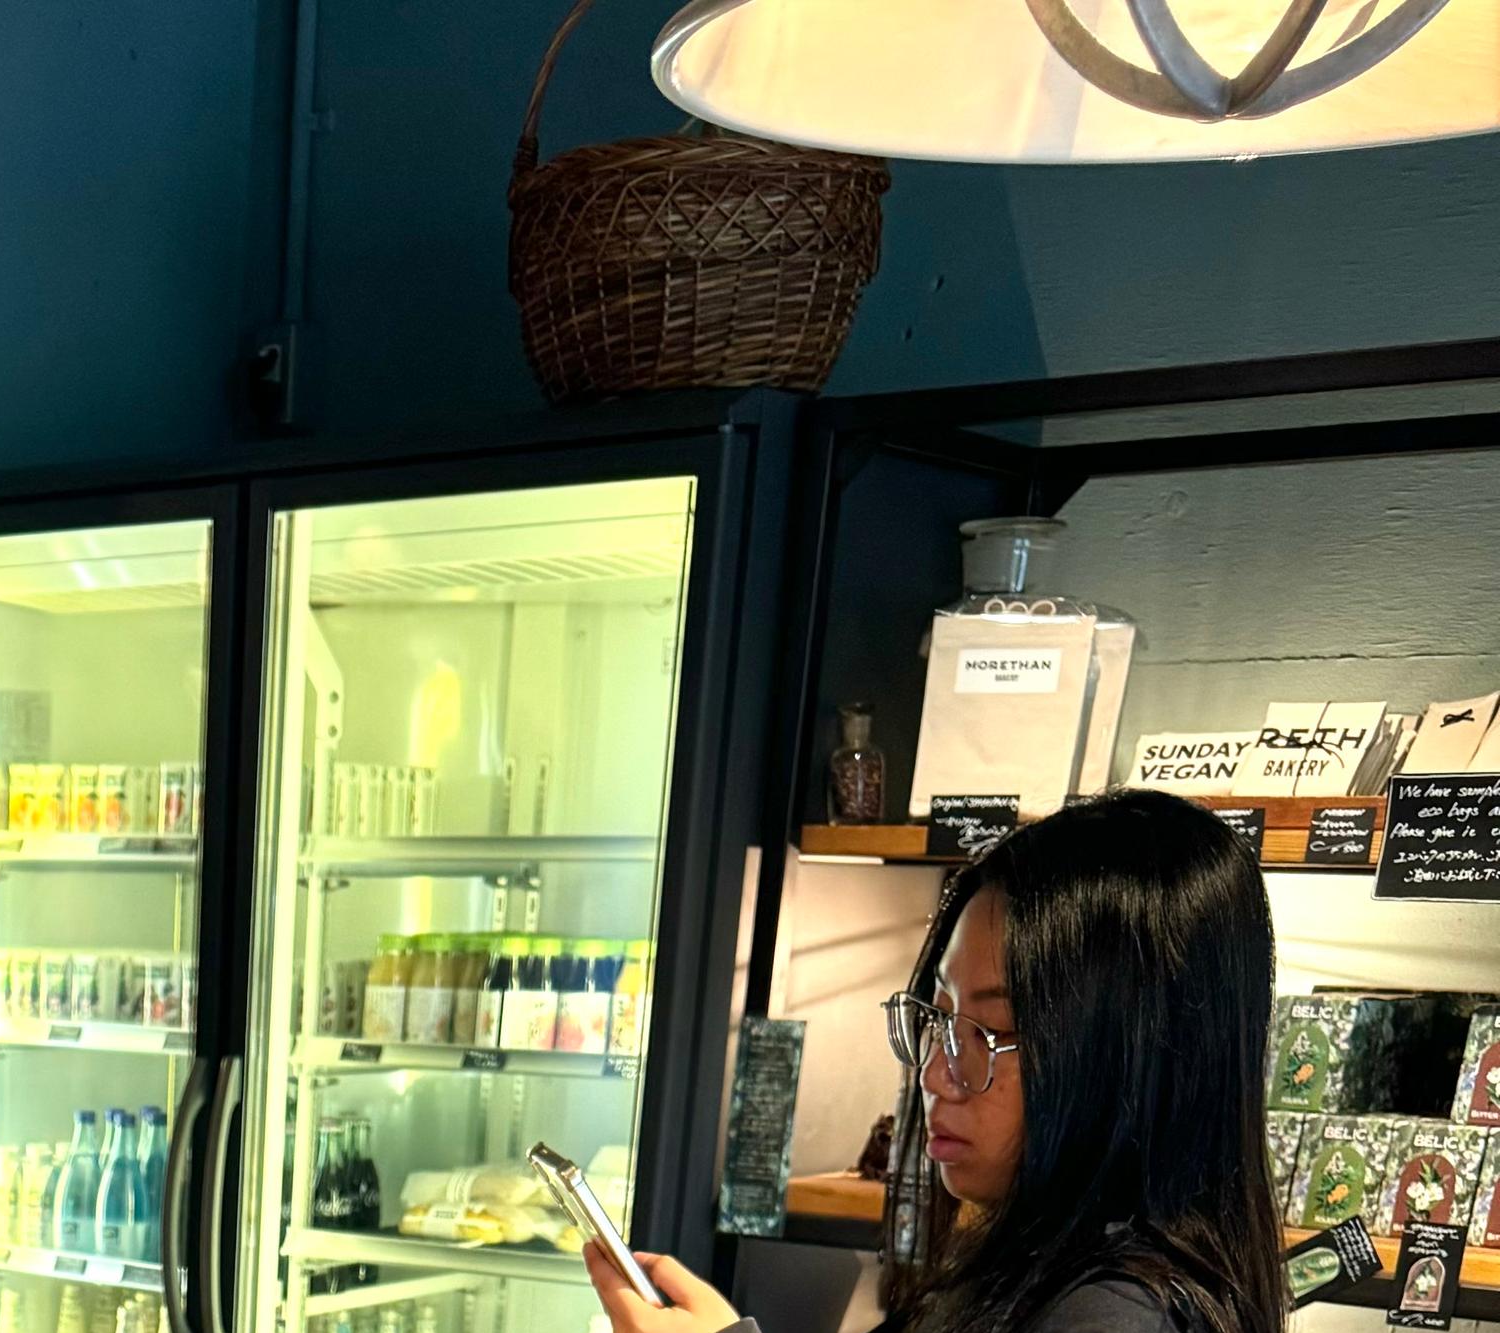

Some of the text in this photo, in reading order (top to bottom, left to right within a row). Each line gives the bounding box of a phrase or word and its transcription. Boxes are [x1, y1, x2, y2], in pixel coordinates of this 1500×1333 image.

[965, 660, 1051, 671] MORETHAN
[1143, 741, 1252, 760] SUNDAY
[1140, 762, 1238, 781] VEGAN
[1263, 760, 1330, 776] BAKERY
[1291, 1005, 1333, 1019] BELIC
[1323, 1125, 1368, 1142] BELIC
[1413, 1134, 1459, 1150] BELIC
